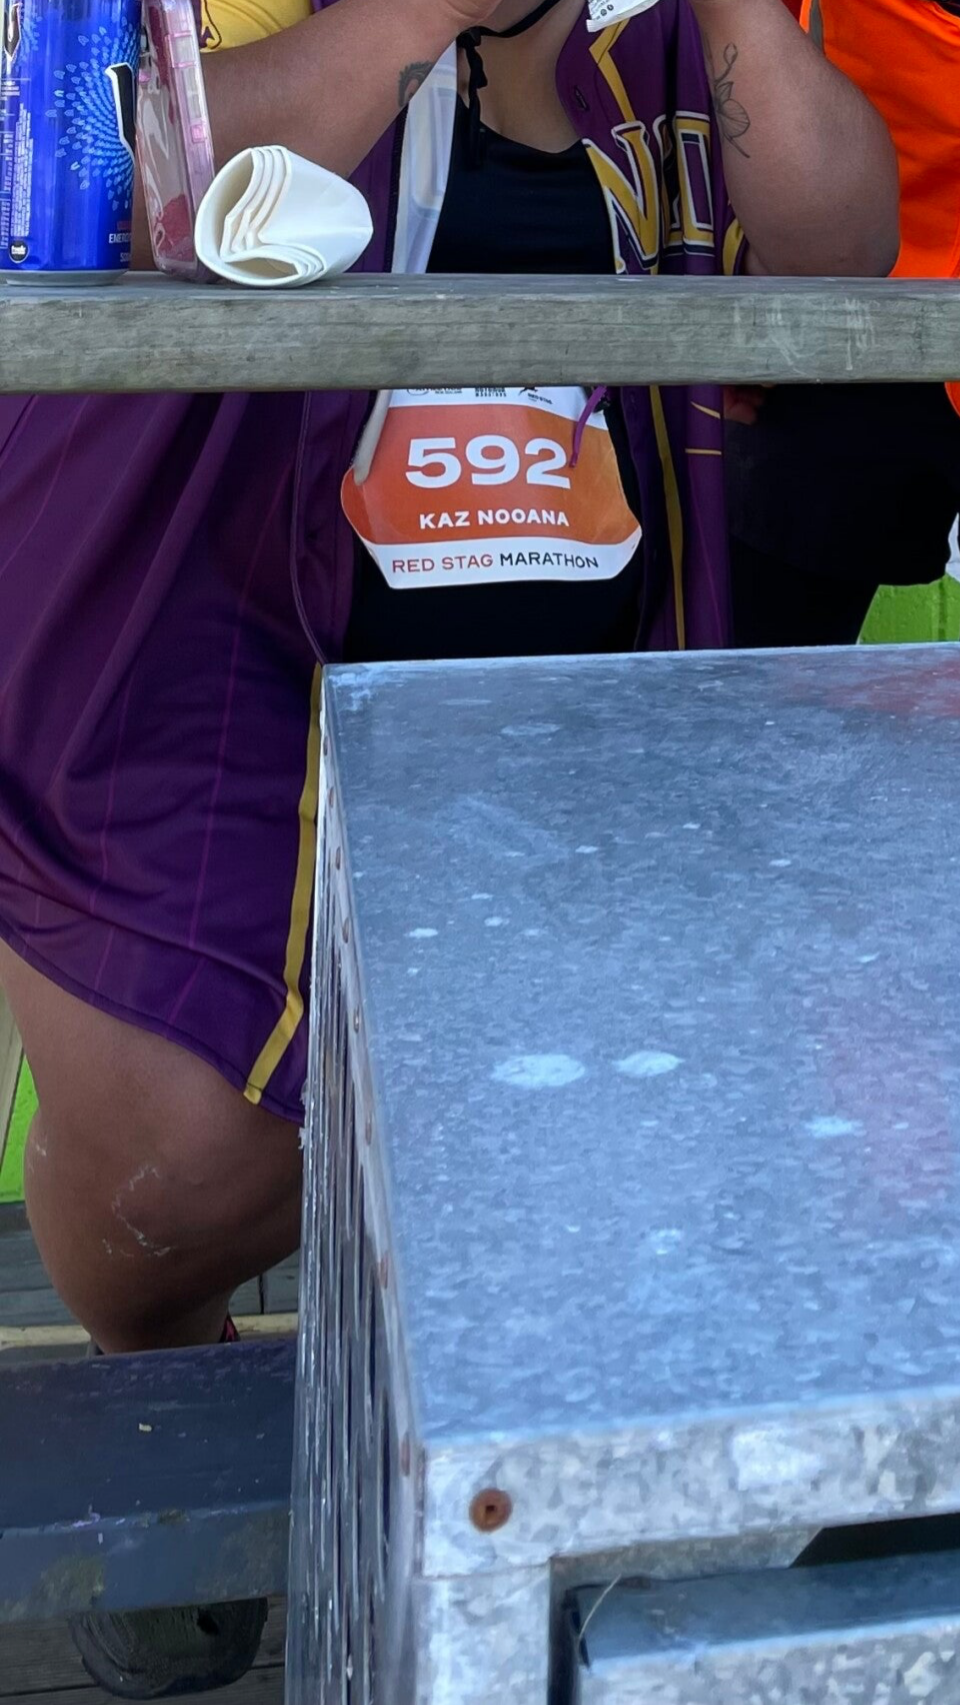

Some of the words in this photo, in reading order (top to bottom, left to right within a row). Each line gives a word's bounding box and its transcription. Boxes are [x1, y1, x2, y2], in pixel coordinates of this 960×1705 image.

[404, 434, 572, 490] 592
[419, 510, 471, 530] KAZ
[477, 507, 570, 528] NOOANA
[392, 558, 436, 574] RED
[441, 553, 494, 571] STAG
[499, 551, 600, 569] MARATHON
